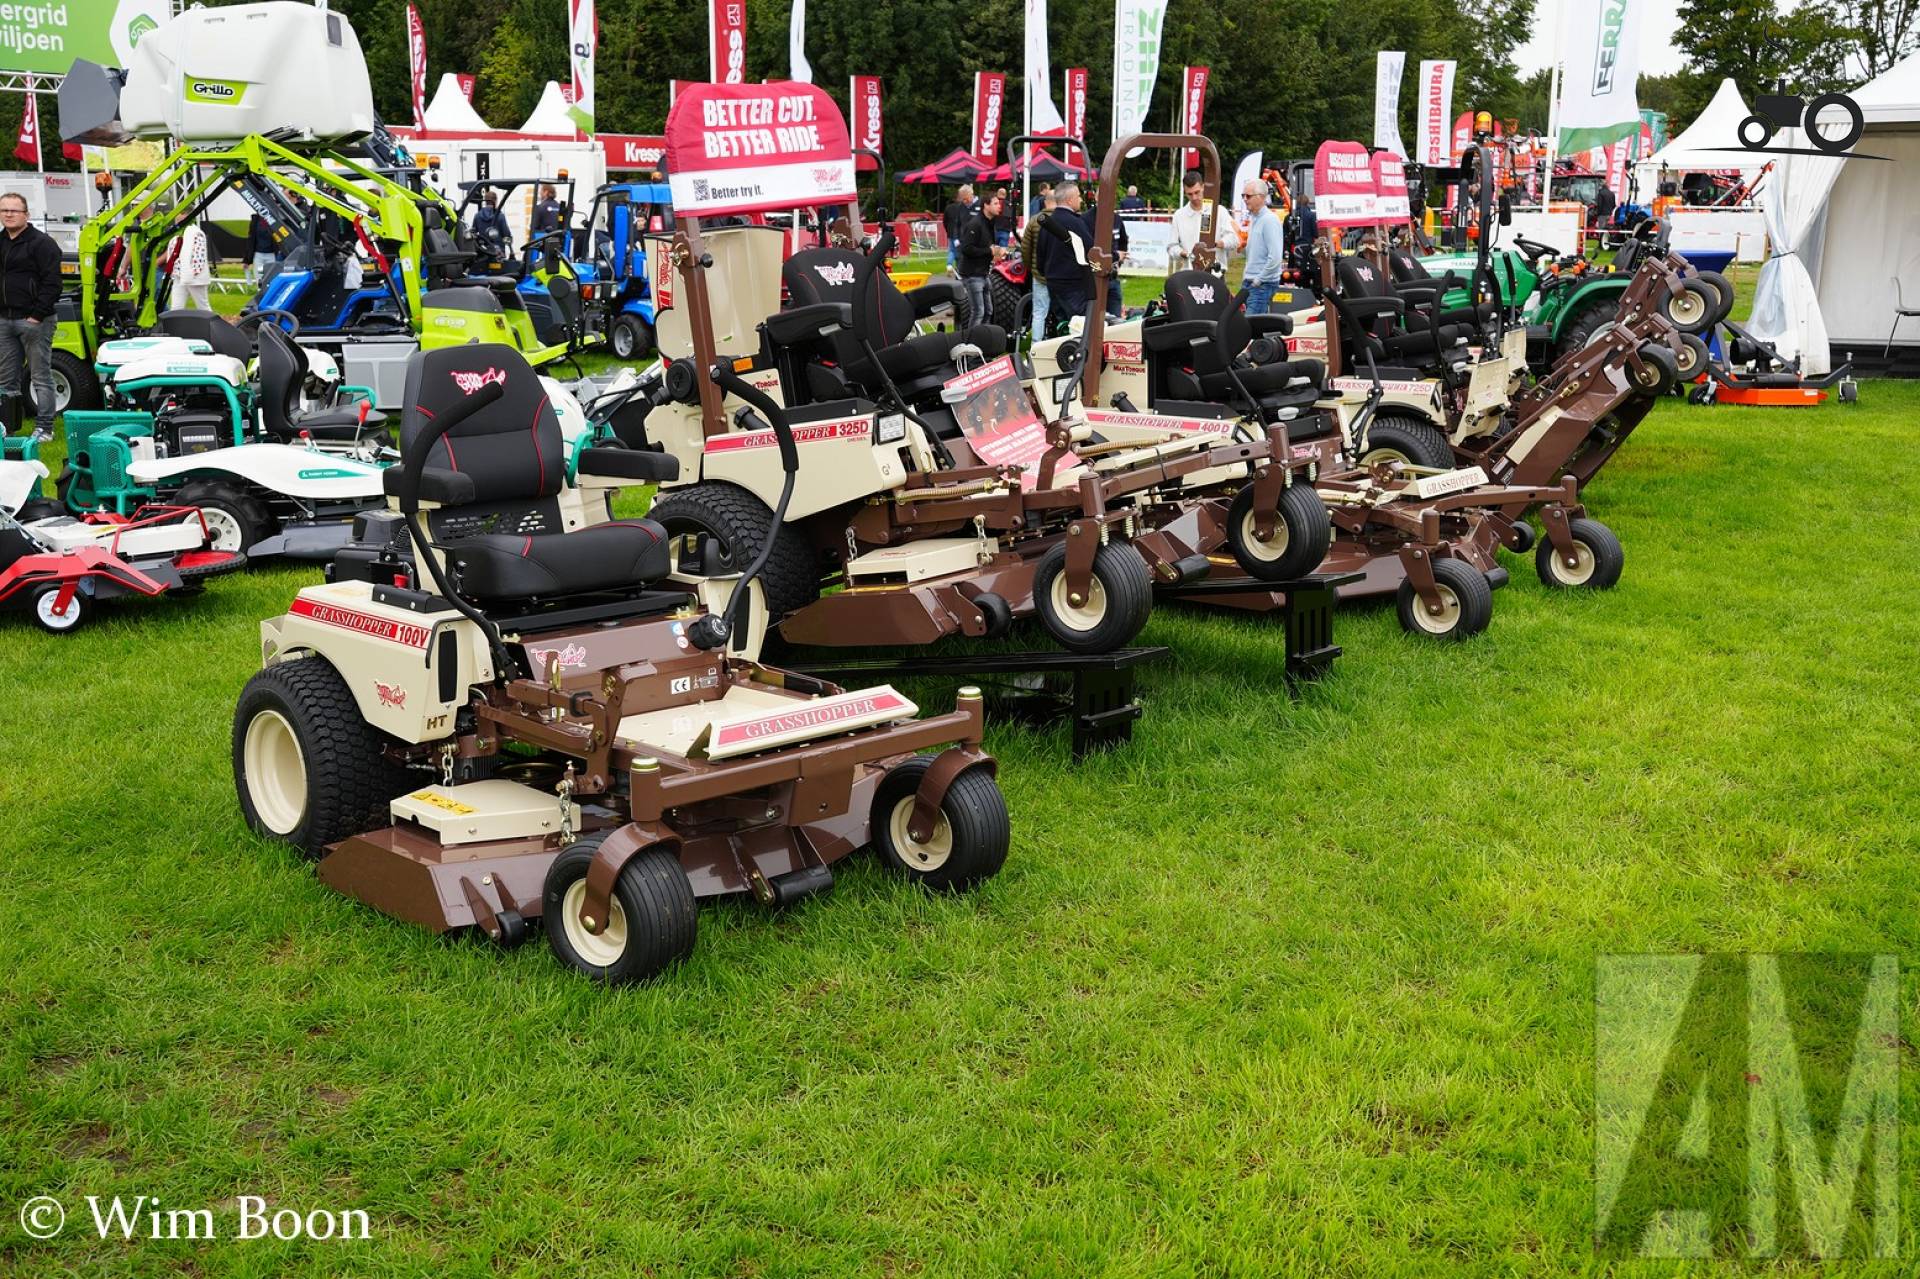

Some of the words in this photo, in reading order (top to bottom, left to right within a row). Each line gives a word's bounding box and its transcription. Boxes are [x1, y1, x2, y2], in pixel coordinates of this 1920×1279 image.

[0, 2, 68, 29] ergrid
[0, 24, 64, 53] iljoen
[1597, 0, 1627, 89] FERR
[726, 29, 743, 84] ess
[1122, 9, 1135, 121] TRADING
[193, 83, 234, 96] Grillo
[1428, 63, 1445, 145] SHIBAURA
[703, 98, 774, 127] BETTER
[777, 95, 817, 123] CUT.
[862, 94, 880, 155] Kress
[980, 94, 1001, 156] Kress
[625, 141, 661, 163] Kress
[703, 129, 777, 158] BETTER
[775, 125, 825, 153] RIDE.
[45, 176, 70, 186] Kress
[711, 186, 739, 200] Better
[740, 186, 753, 198] try
[839, 420, 869, 436] 325D
[1104, 415, 1183, 429] GRASSHOPPER
[311, 605, 392, 637] GRASSHOPPER
[399, 625, 429, 647] 100V
[427, 715, 448, 730] HT
[746, 700, 876, 738] GRASSHOPPER
